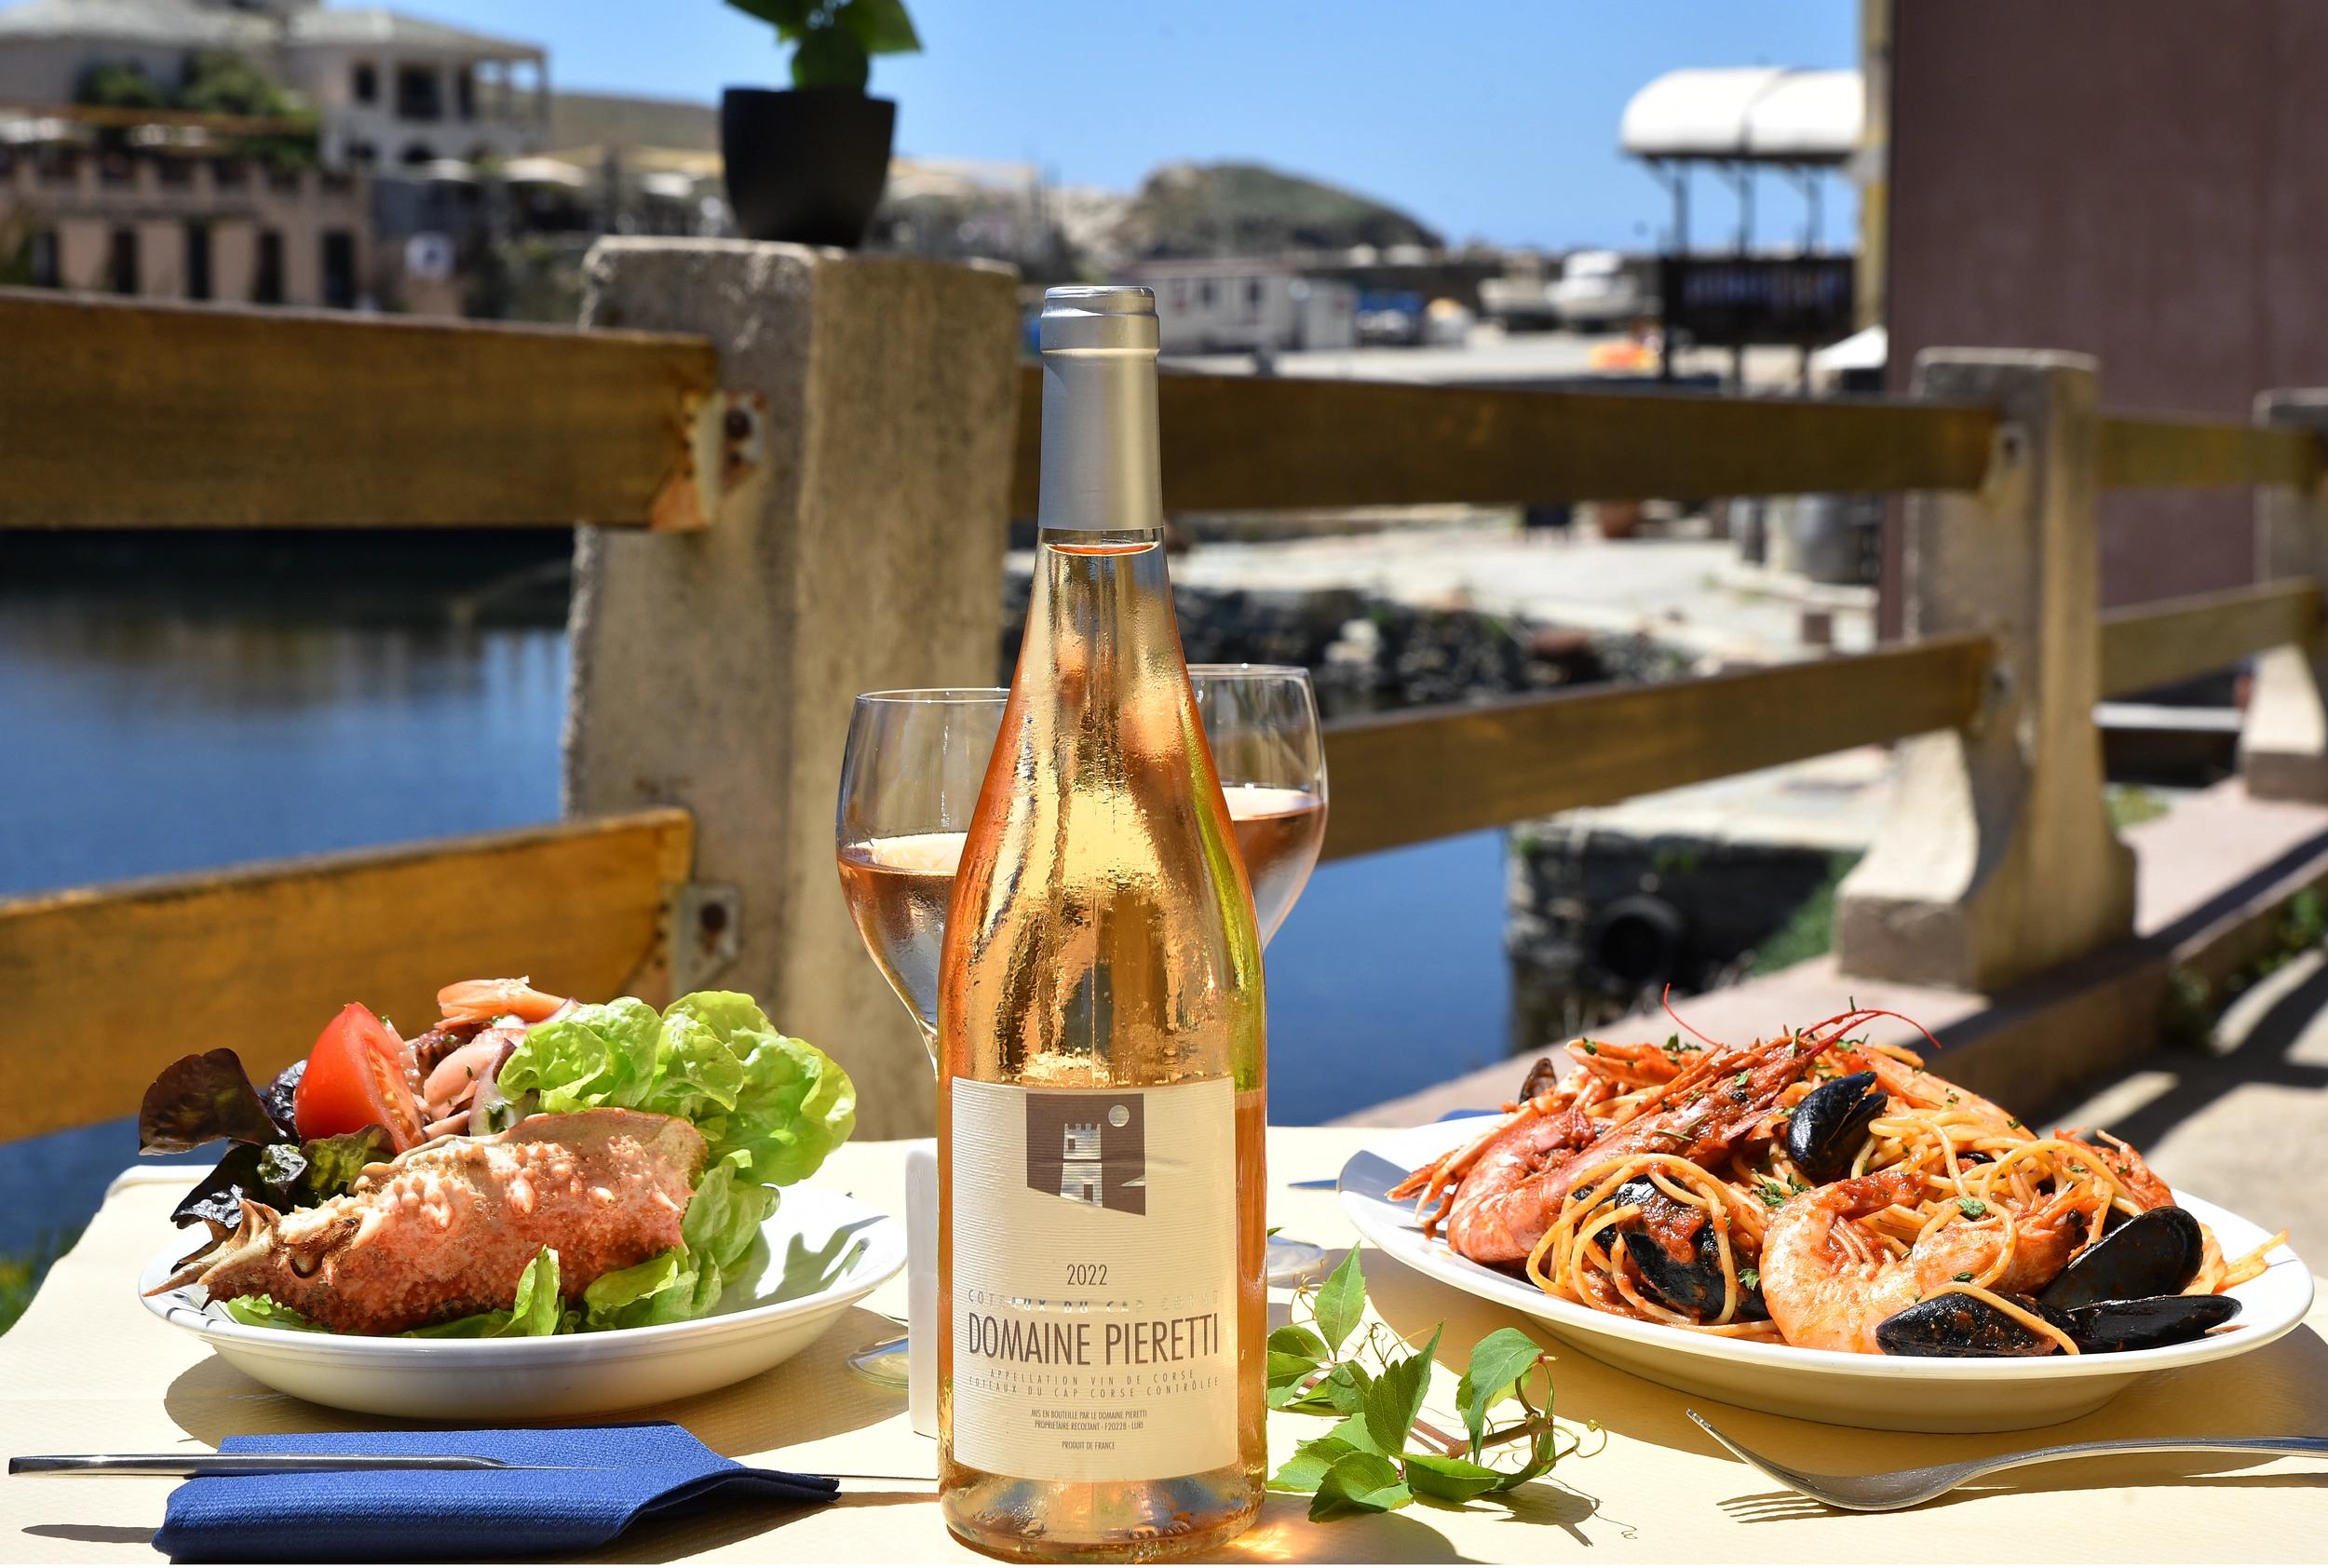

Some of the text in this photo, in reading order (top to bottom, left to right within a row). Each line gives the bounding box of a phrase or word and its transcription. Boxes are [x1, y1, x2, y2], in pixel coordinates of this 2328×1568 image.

[1066, 1264, 1107, 1286] 2022
[1063, 1300, 1088, 1314] DU
[969, 1312, 1217, 1365] DOMAINE PIERETTI
[990, 1369, 1193, 1386] APPELLATION VIN DE CORSE
[969, 1376, 1017, 1394] COTEAUX
[1028, 1386, 1042, 1396] DU
[1054, 1388, 1078, 1398] CAP
[1090, 1388, 1134, 1399] CORSE
[1031, 1409, 1147, 1420] MIS EN BOUTEILLE PAR LE DOMAINE PIERETTI
[1062, 1440, 1115, 1450] PRODUIT DE FRANCE
